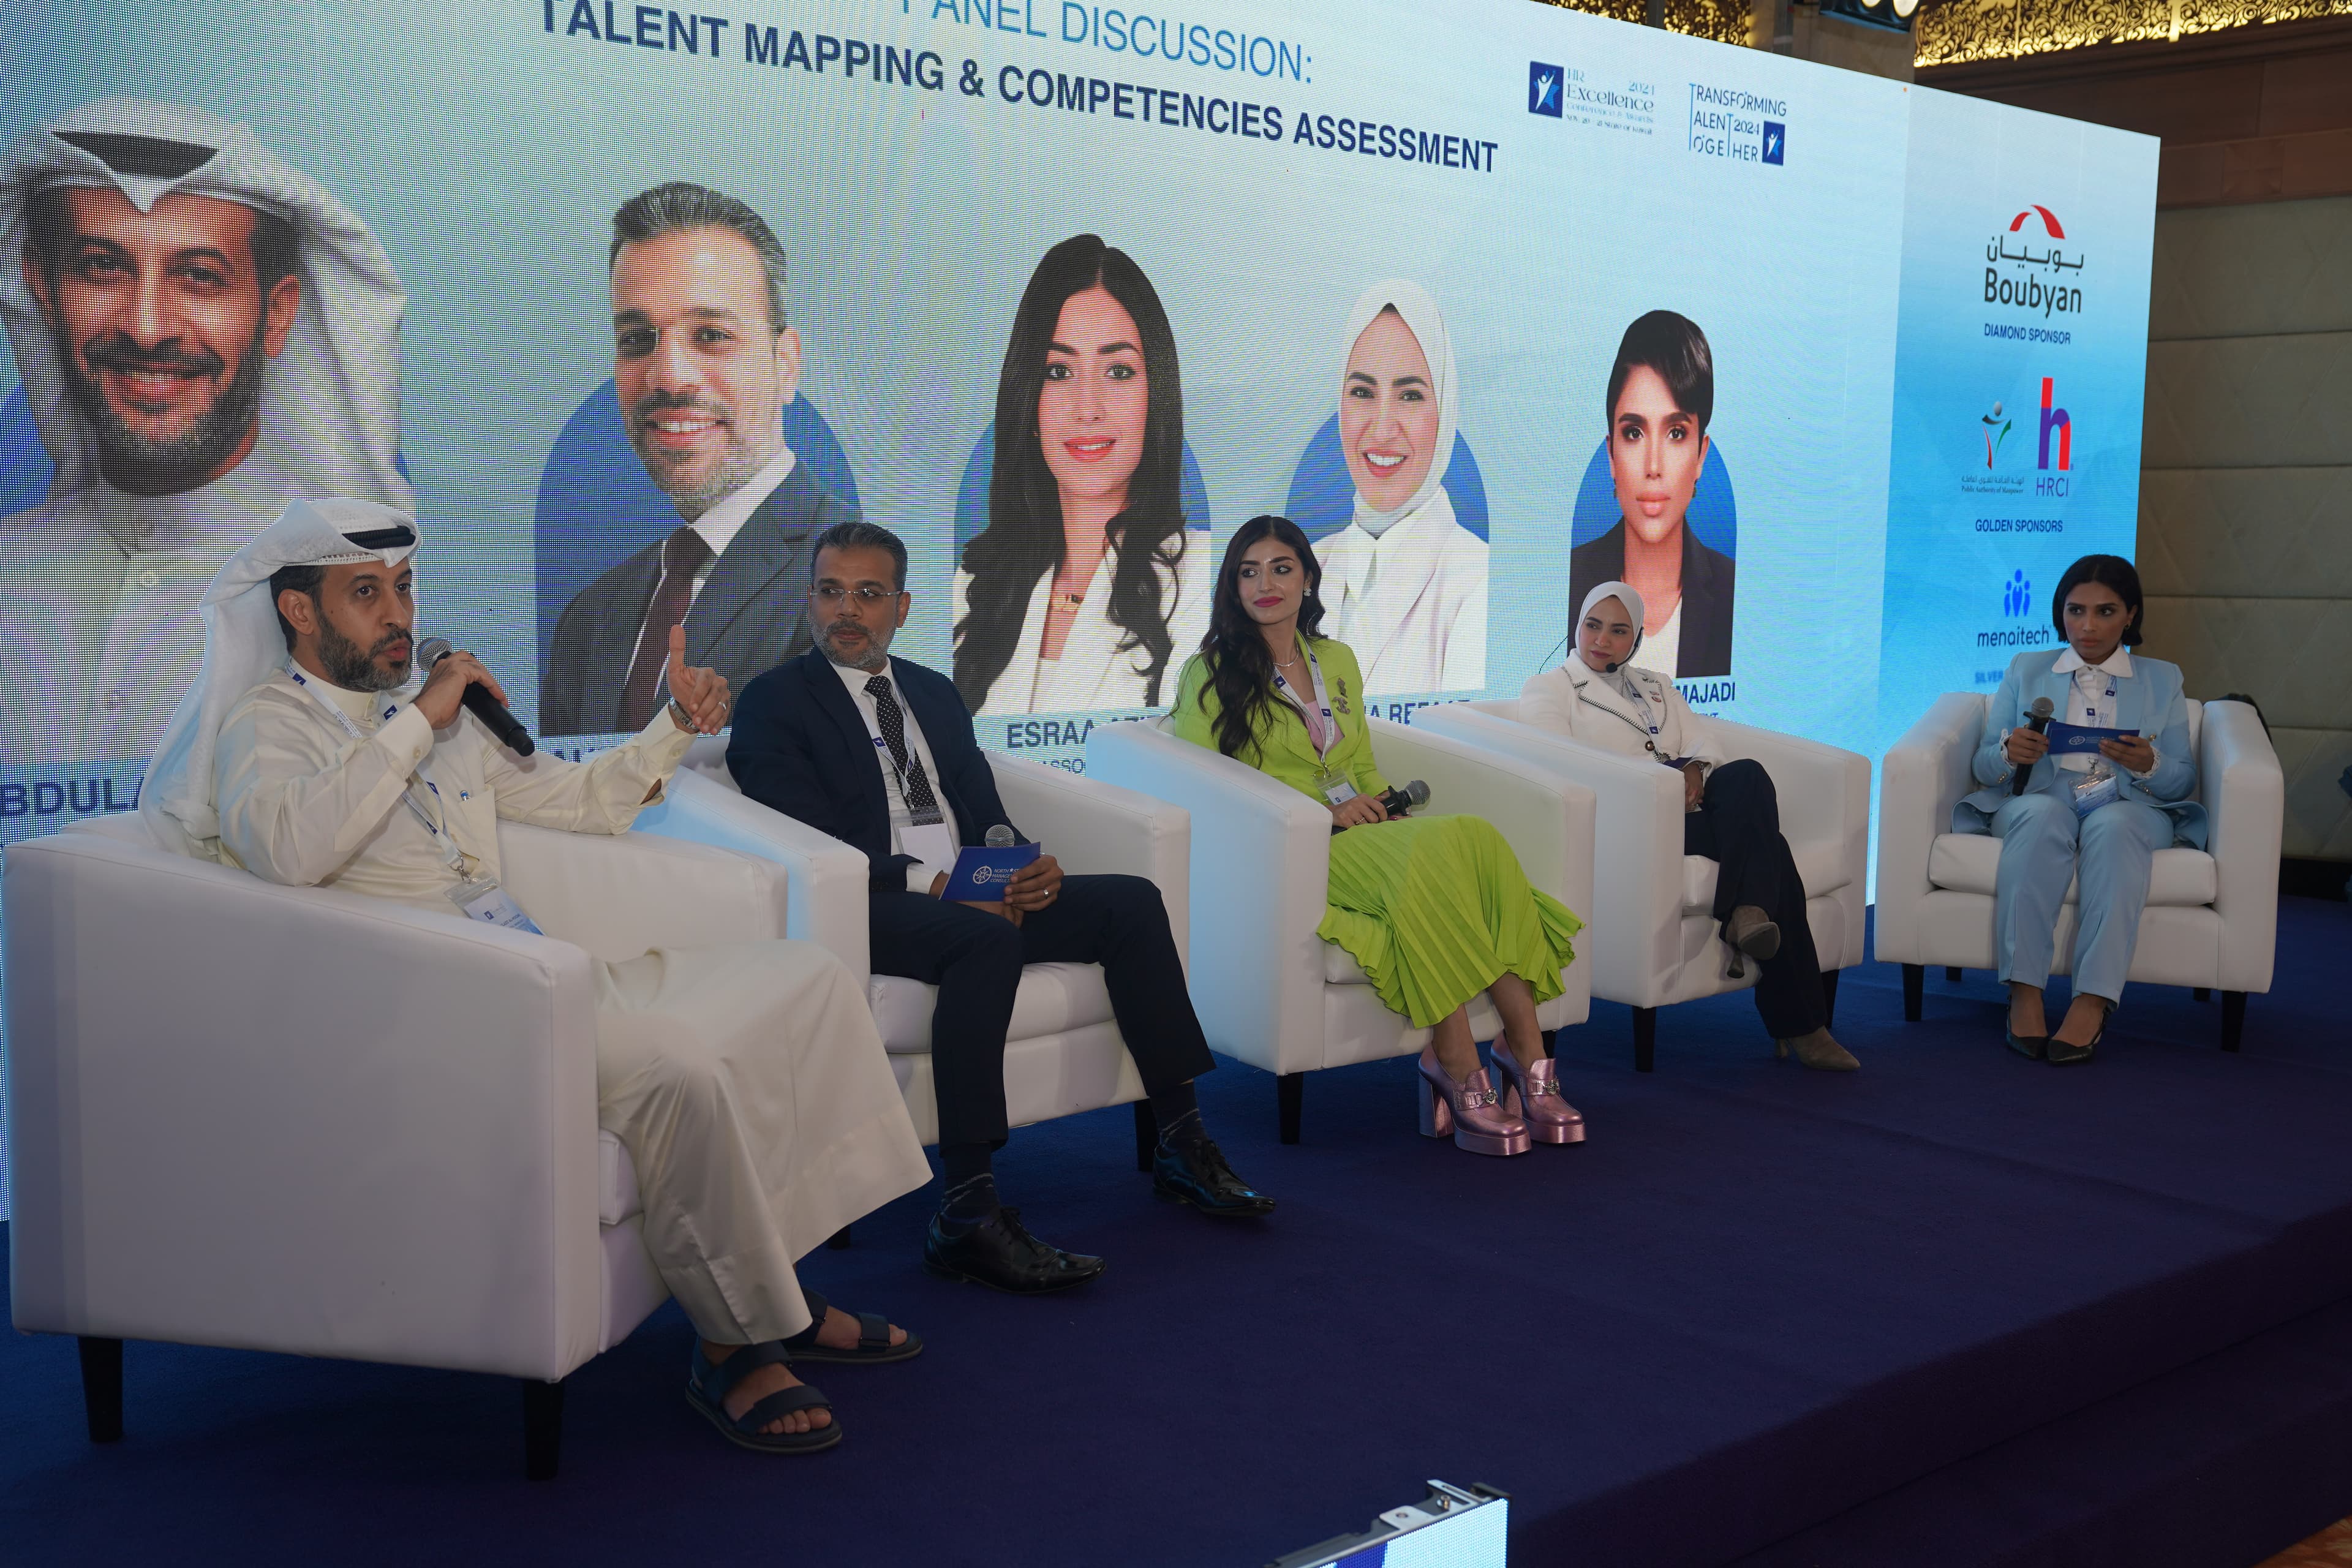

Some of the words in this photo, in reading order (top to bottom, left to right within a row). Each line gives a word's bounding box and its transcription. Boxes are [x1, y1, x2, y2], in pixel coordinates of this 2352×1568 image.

[1062, 1, 1312, 83] DISCUSSION:
[543, 0, 729, 58] TALENT
[745, 23, 943, 91] MAPPING
[959, 59, 985, 97] &
[999, 65, 1283, 141] COMPETENCIES
[1293, 112, 1498, 173] ASSESSMENT
[1567, 84, 1654, 112] Excellence
[1689, 83, 1787, 117] TRANSFORMING
[1734, 119, 1759, 135] 2024
[1987, 235, 2084, 276] بوبيان
[1985, 267, 2081, 319] Boubyan
[1984, 323, 2026, 340] DIAMOND
[2029, 328, 2071, 344] SPONSOR
[2036, 477, 2069, 497] HRCI
[1975, 519, 2013, 532] GOLDEN
[2015, 519, 2063, 532] SPONSORS
[1978, 625, 2049, 647] menaitech
